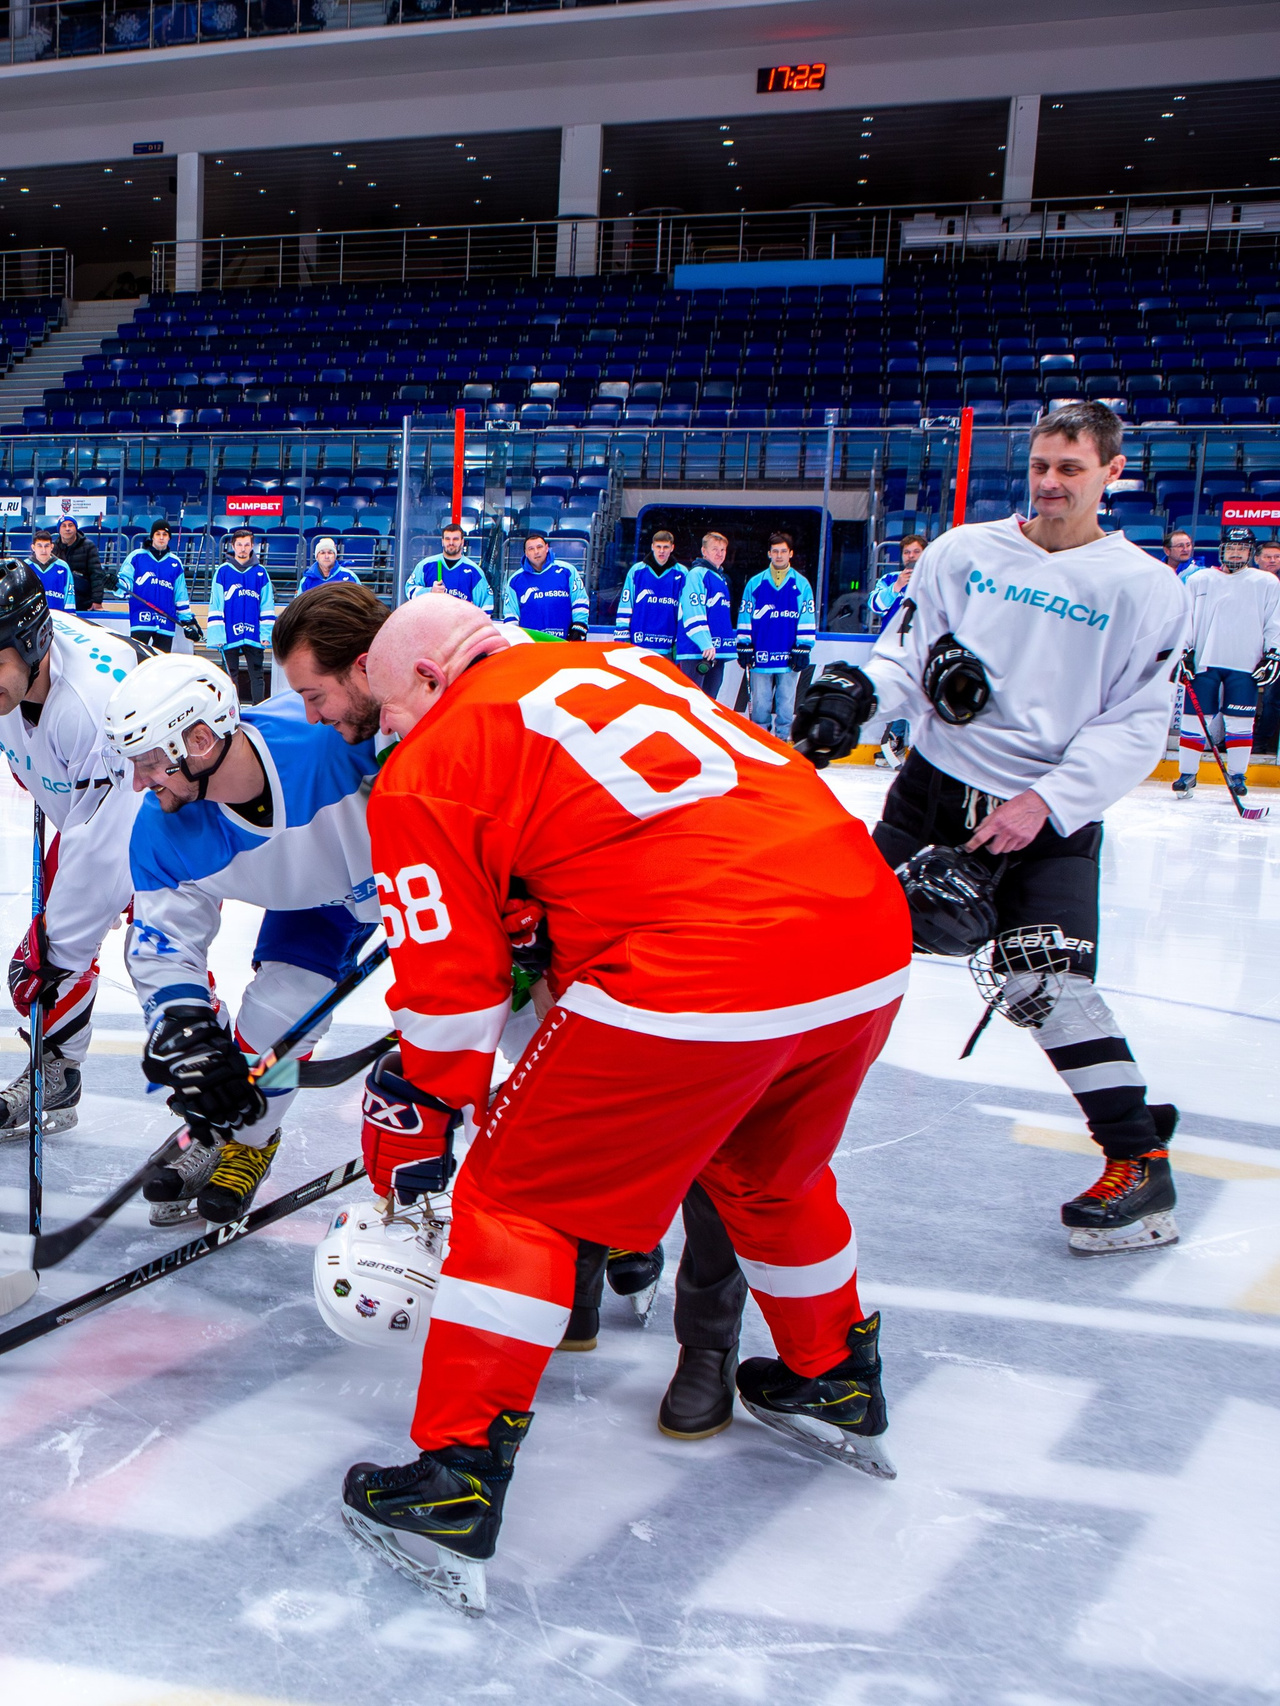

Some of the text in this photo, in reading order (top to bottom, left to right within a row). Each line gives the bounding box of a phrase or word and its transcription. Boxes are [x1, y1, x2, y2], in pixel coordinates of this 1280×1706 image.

[767, 63, 826, 90] 17:22
[228, 502, 281, 511] OLIMPBET
[689, 591, 707, 606] 39
[1004, 584, 1110, 631] МЕДСИ
[168, 706, 194, 729] CCM
[374, 863, 452, 949] 68
[129, 1238, 210, 1288] ALPHA
[357, 1258, 404, 1275] BAUER
